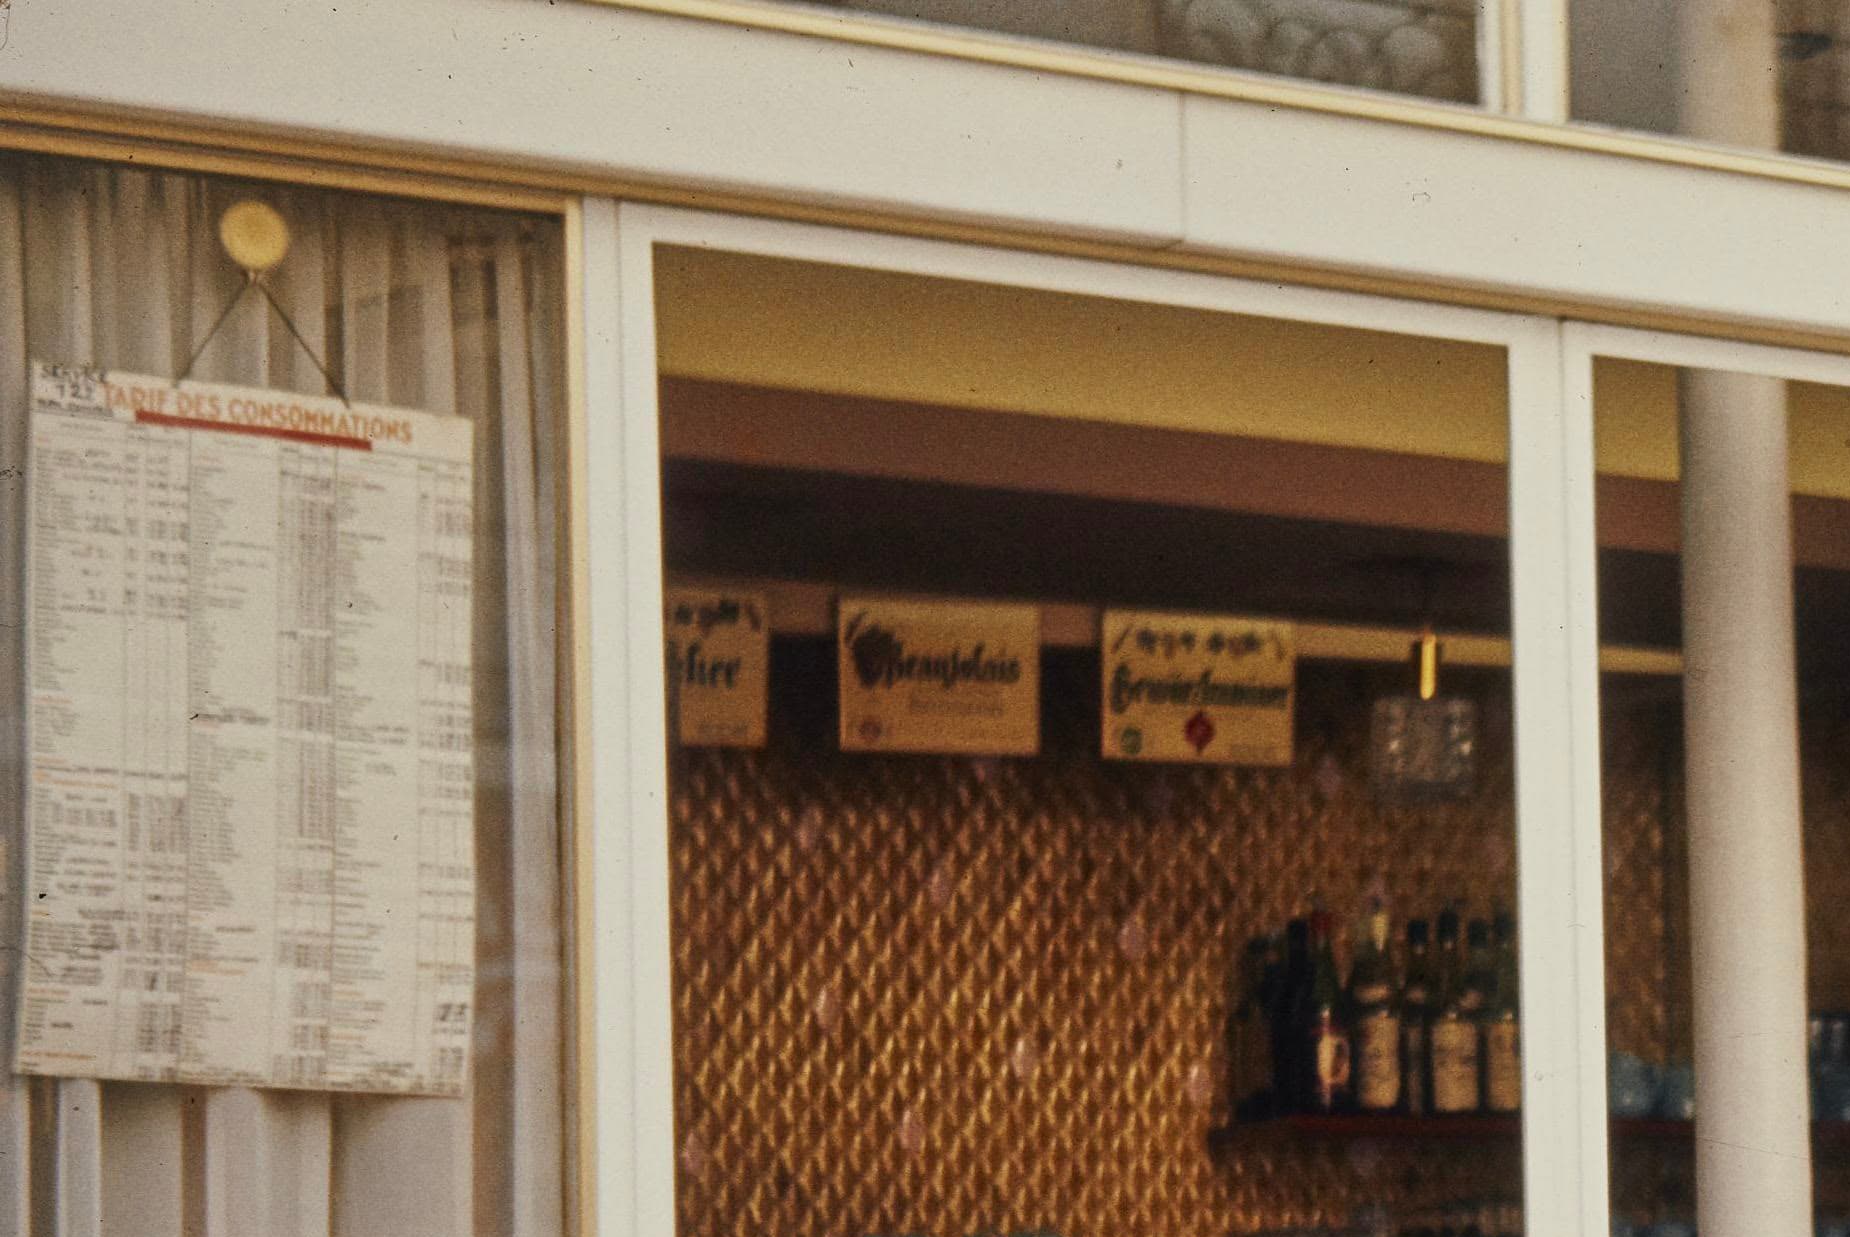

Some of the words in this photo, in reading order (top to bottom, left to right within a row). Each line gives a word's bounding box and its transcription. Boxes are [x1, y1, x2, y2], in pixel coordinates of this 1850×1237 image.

[103, 382, 167, 412] TARIF
[176, 391, 220, 422] DES
[228, 399, 413, 444] CONSOMMATIONS
